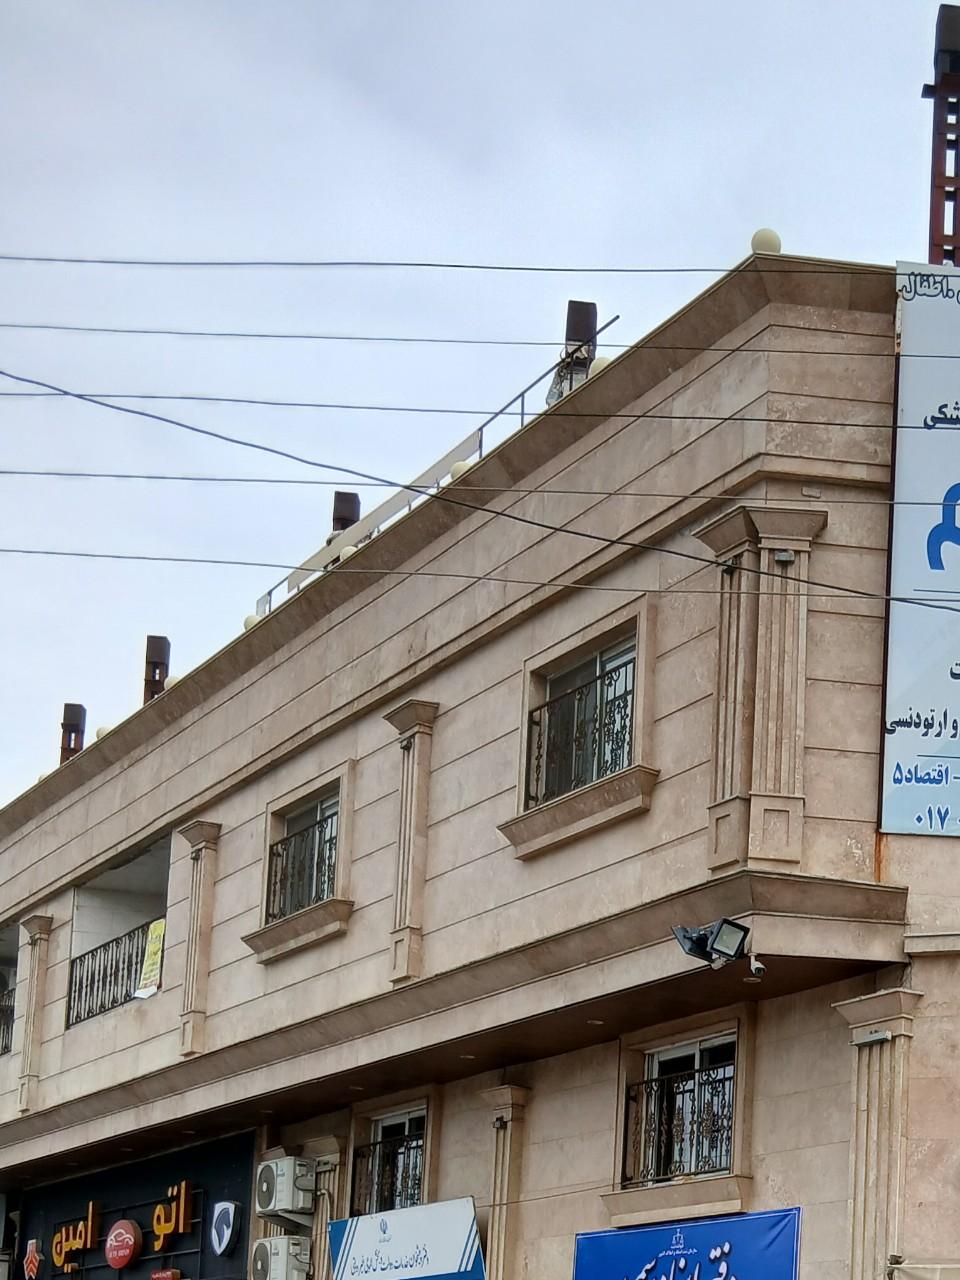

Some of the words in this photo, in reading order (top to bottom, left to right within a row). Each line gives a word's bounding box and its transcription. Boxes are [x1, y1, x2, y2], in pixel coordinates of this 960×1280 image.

[884, 706, 948, 738] ارتودنسی
[951, 721, 959, 739] و
[52, 1200, 94, 1273] امین
[152, 1180, 187, 1251] اتو
